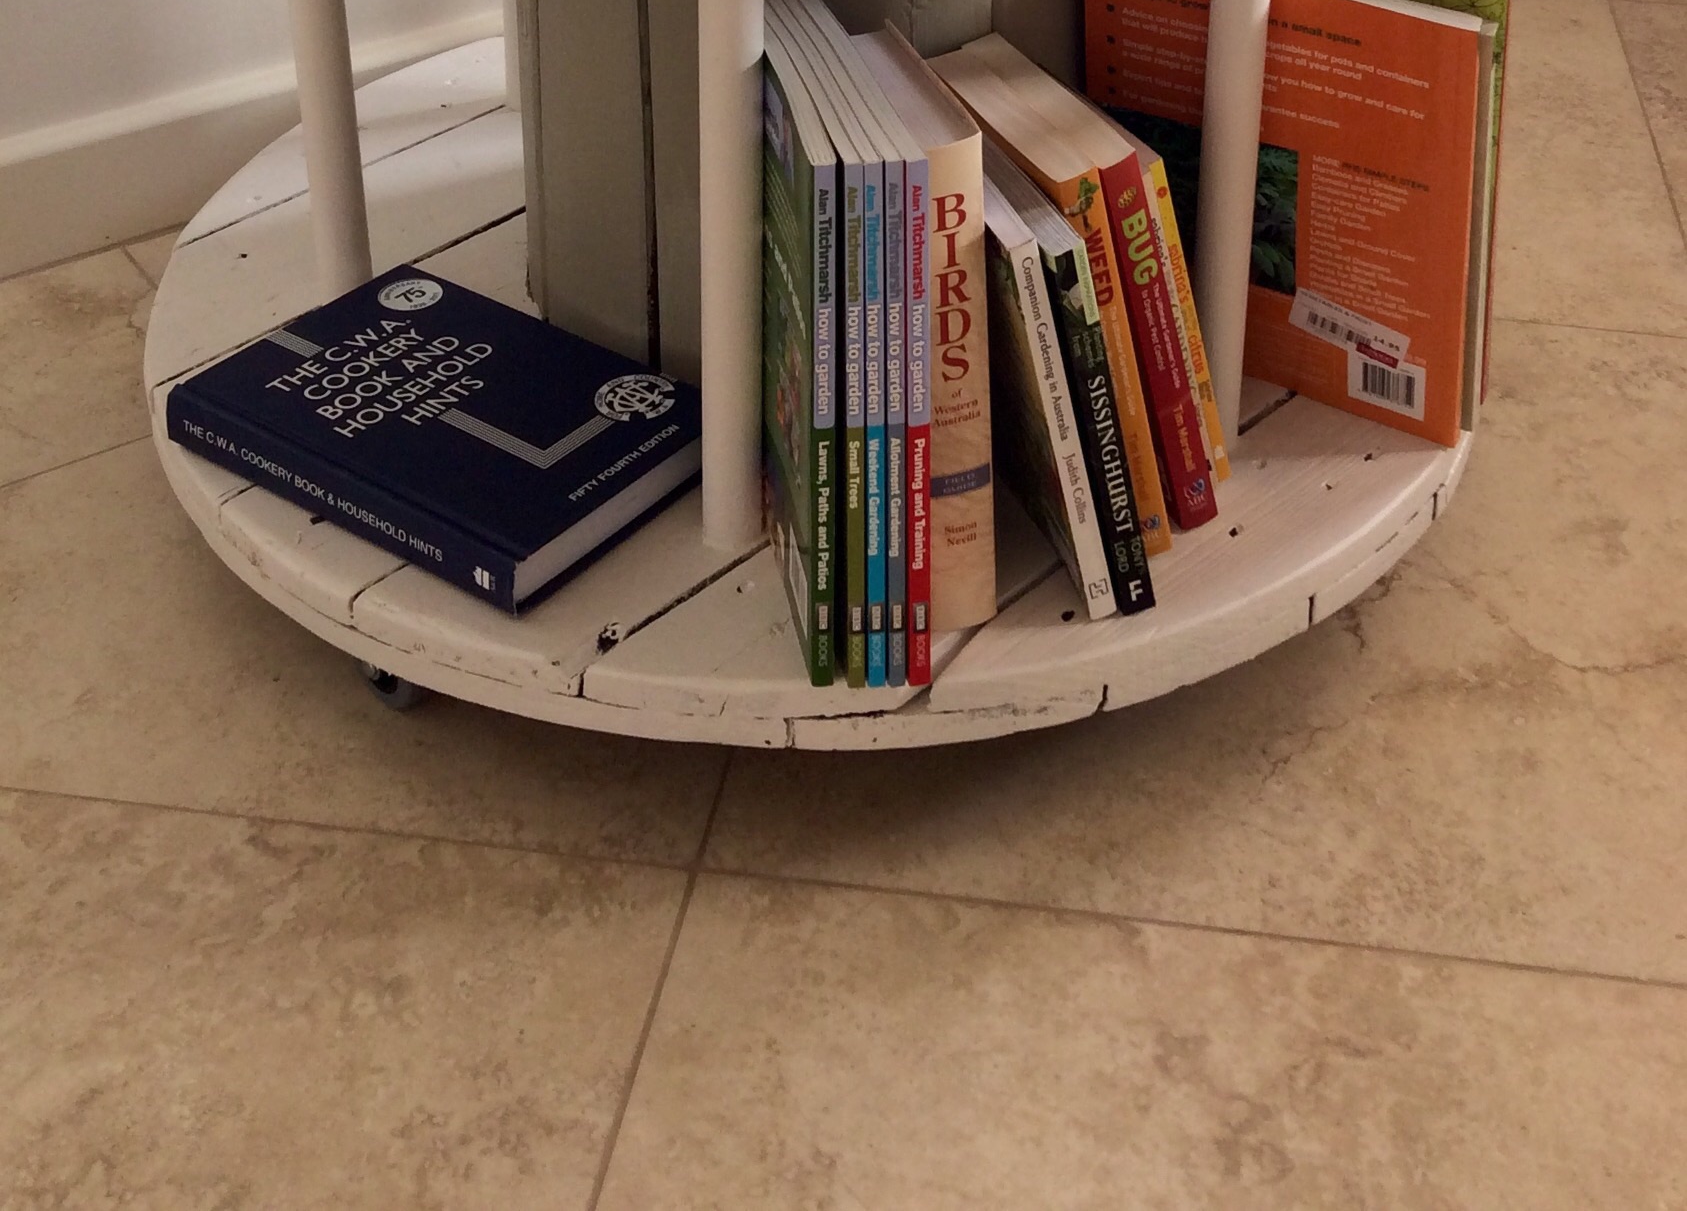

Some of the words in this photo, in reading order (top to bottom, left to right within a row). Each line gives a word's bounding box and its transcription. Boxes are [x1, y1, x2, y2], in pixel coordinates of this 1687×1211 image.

[1291, 23, 1323, 38] small
[1326, 32, 1361, 47] space
[1295, 57, 1307, 67] all
[1309, 61, 1331, 73] year
[1333, 67, 1362, 81] round
[1314, 49, 1328, 60] for
[1330, 55, 1353, 68] pots
[1355, 62, 1374, 74] and
[1376, 67, 1430, 89] containers
[1280, 77, 1299, 88] you
[1301, 80, 1322, 92] how
[1325, 85, 1335, 95] to
[1337, 89, 1363, 102] grow
[1365, 96, 1384, 108] and
[1410, 109, 1425, 120] for
[818, 188, 828, 216] Alan
[866, 184, 876, 212] Alan
[912, 185, 922, 212] Alan
[818, 216, 833, 304] Titchmarsh
[848, 214, 862, 304] Titchmarsh
[867, 213, 881, 302] Titchmarsh
[888, 210, 904, 299] Titchmarsh
[912, 212, 926, 301] Titchmarsh
[1121, 208, 1158, 286] BUG
[1085, 227, 1114, 307] WEED
[394, 287, 426, 303] 75
[932, 193, 971, 383] BIRDS
[1021, 256, 1042, 321] Companion
[1141, 289, 1147, 299] to
[1152, 282, 1161, 298] The
[818, 307, 832, 340] how
[847, 305, 862, 338] how
[867, 304, 881, 336] how
[888, 302, 903, 336] how
[912, 303, 926, 336] how
[1109, 306, 1117, 321] The
[1143, 298, 1154, 328] Organic
[1155, 298, 1168, 329] Ultimate
[1168, 243, 1190, 304] sabrina's
[1187, 334, 1205, 375] citrus
[817, 343, 831, 360] to
[847, 343, 861, 361] to
[868, 341, 881, 358] to
[889, 339, 903, 356] to
[912, 341, 926, 358] to
[1036, 322, 1055, 381] Gardening
[1072, 335, 1082, 357] from
[1151, 327, 1159, 344] Pest
[1162, 329, 1177, 368] Gardener's
[266, 360, 328, 394] THE
[325, 316, 413, 363] C.W.A.
[303, 329, 426, 402] COOKERY
[1153, 344, 1166, 372] Control
[316, 370, 403, 421] BOOK
[402, 335, 461, 381] AND
[333, 342, 494, 439] HOUSEHOLD
[815, 364, 832, 416] garden
[846, 363, 862, 417] garden
[866, 361, 881, 415] garden
[888, 359, 903, 412] garden
[911, 360, 926, 414] garden
[951, 388, 964, 399] of
[1049, 380, 1058, 392] in
[1170, 367, 1181, 389] Guide
[401, 375, 486, 426] HINTS
[933, 399, 978, 417] Western
[933, 408, 981, 428] Australia
[1051, 395, 1069, 442] Australia
[1172, 403, 1185, 426] Tim
[568, 477, 597, 503] FIFTY
[597, 449, 640, 483] FOURTH
[638, 423, 681, 456] EDITION
[816, 440, 830, 485] Lawns,
[849, 440, 860, 470] Small
[868, 438, 880, 494] Weekend
[889, 437, 901, 495] Allotment
[912, 438, 926, 490] Pruning
[1087, 375, 1134, 534] SISSINGHURST
[1176, 426, 1196, 473] Marshall
[1062, 453, 1080, 487] Judith
[183, 419, 204, 440] THE
[205, 430, 239, 456] C.W.A.
[240, 448, 293, 483] COOKERY
[294, 475, 326, 500] BOOK
[326, 490, 336, 506] &
[336, 497, 408, 543] HOUSEHOLD
[408, 533, 444, 563] HINTS
[817, 487, 830, 523] Paths
[849, 471, 861, 509] Trees
[914, 492, 926, 517] and
[1073, 487, 1087, 524] Collins
[817, 524, 830, 549] and
[868, 495, 880, 556] Gardening
[888, 496, 902, 558] Gardening
[944, 521, 977, 536] Simon
[946, 532, 977, 548] Nevill
[912, 518, 926, 570] Training
[1114, 541, 1130, 573] LORD
[1130, 535, 1144, 566] TONY
[817, 551, 829, 591] Patios
